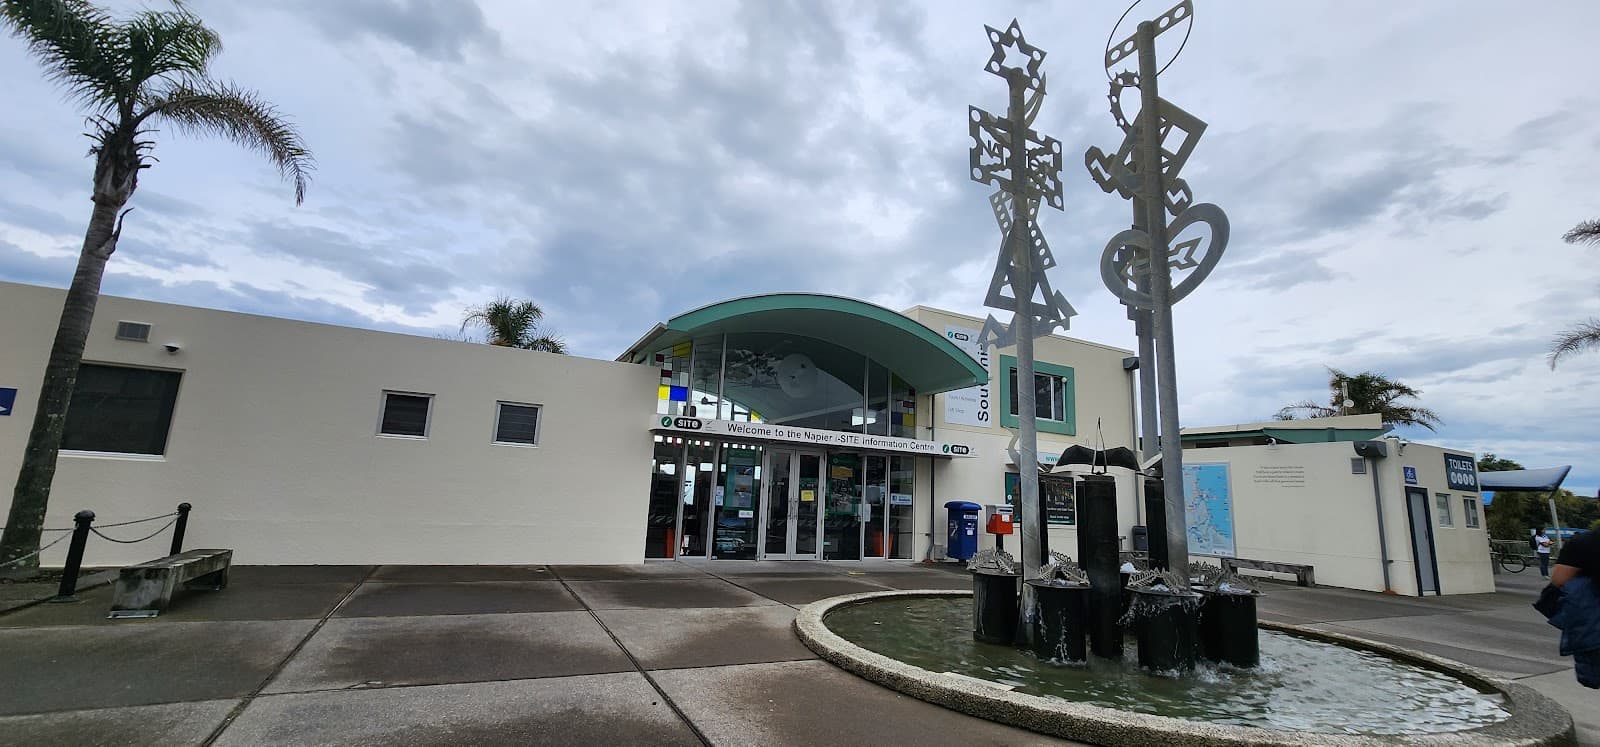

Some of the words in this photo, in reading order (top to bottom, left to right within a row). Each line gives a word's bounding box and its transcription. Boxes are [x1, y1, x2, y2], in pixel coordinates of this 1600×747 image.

[727, 423, 771, 436] Welcome
[775, 428, 784, 437] to
[787, 430, 802, 439] the
[804, 431, 833, 443] Napier
[862, 437, 908, 449] Information
[909, 441, 935, 451] Centre
[1448, 458, 1473, 472] TOILETS
